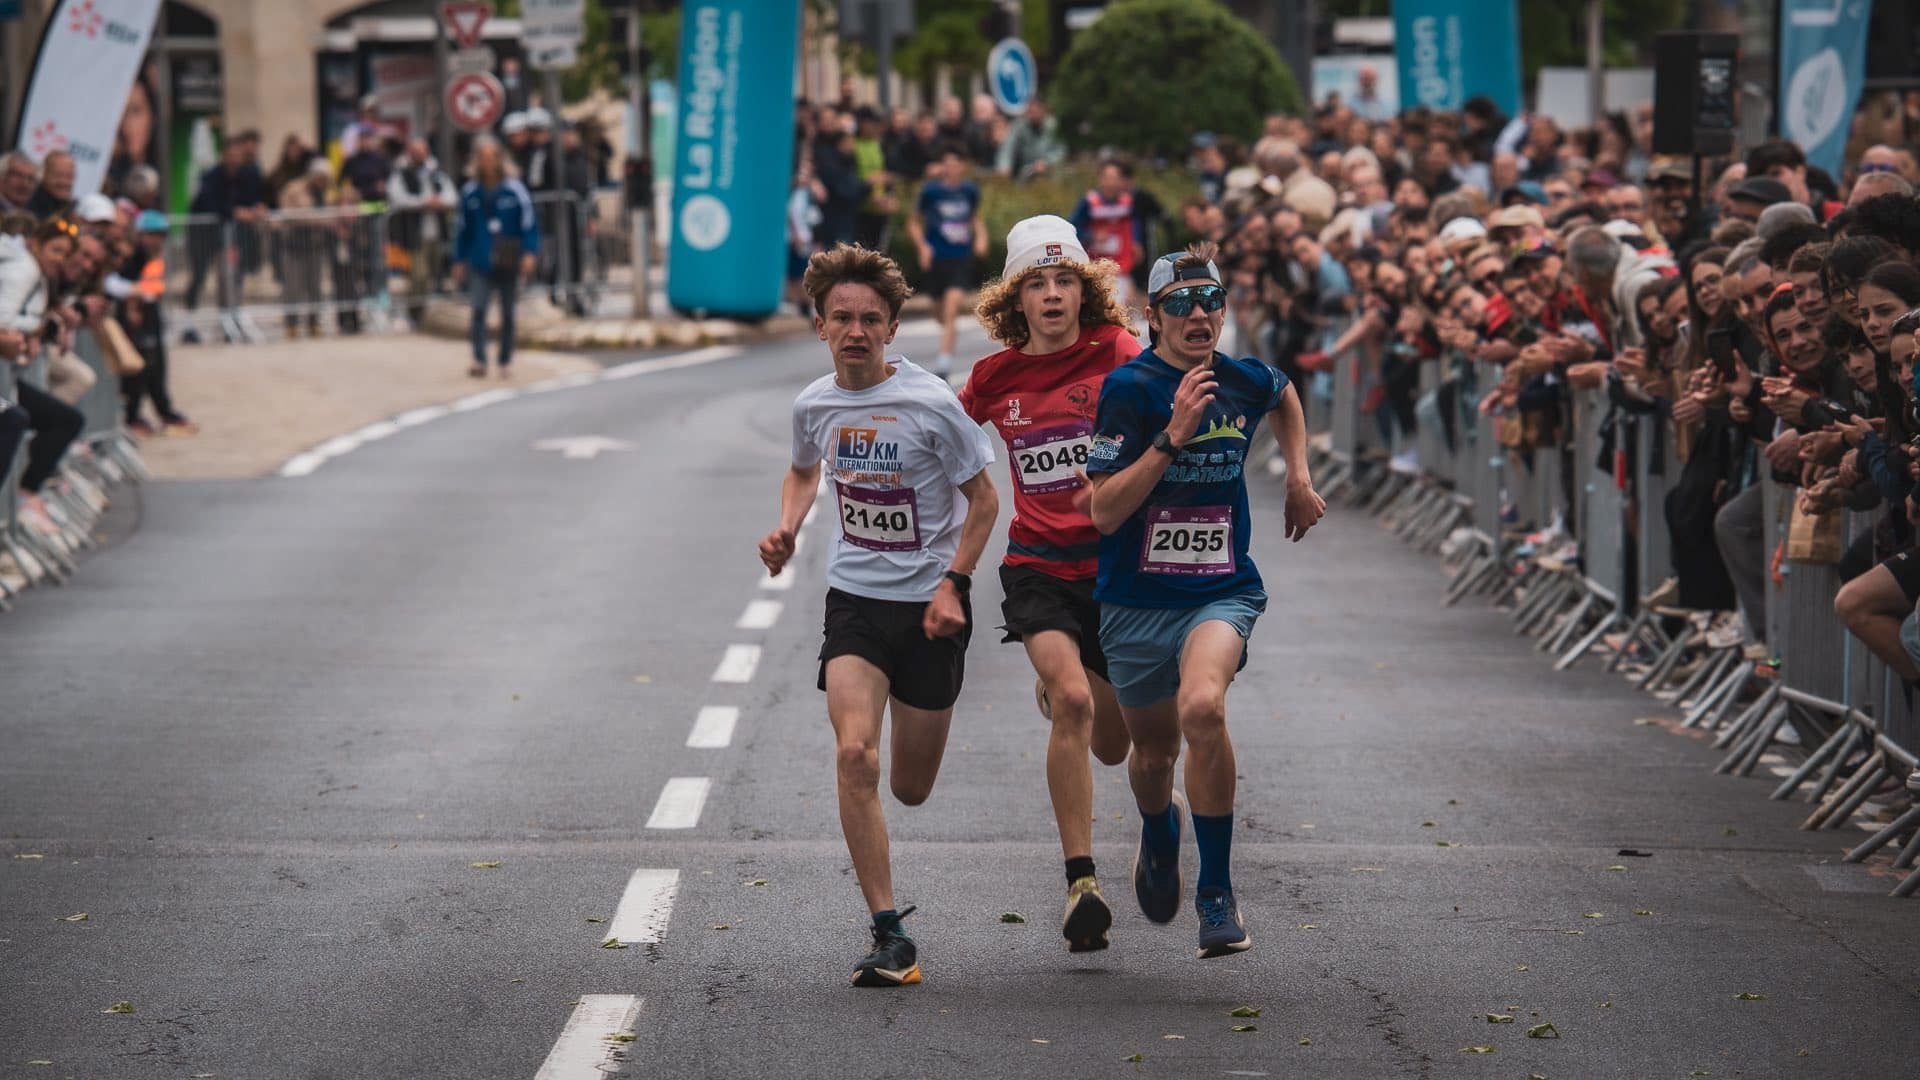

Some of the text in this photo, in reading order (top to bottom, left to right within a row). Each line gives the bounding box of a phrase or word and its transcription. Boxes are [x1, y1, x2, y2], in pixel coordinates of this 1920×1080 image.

[1407, 16, 1449, 106] gion
[682, 6, 724, 189] La Région
[847, 430, 899, 461] 15 KM
[1019, 443, 1089, 474] 2048
[836, 458, 903, 473] INTERNATIONAUX
[843, 503, 908, 532] 2140
[1152, 528, 1225, 553] 2055
